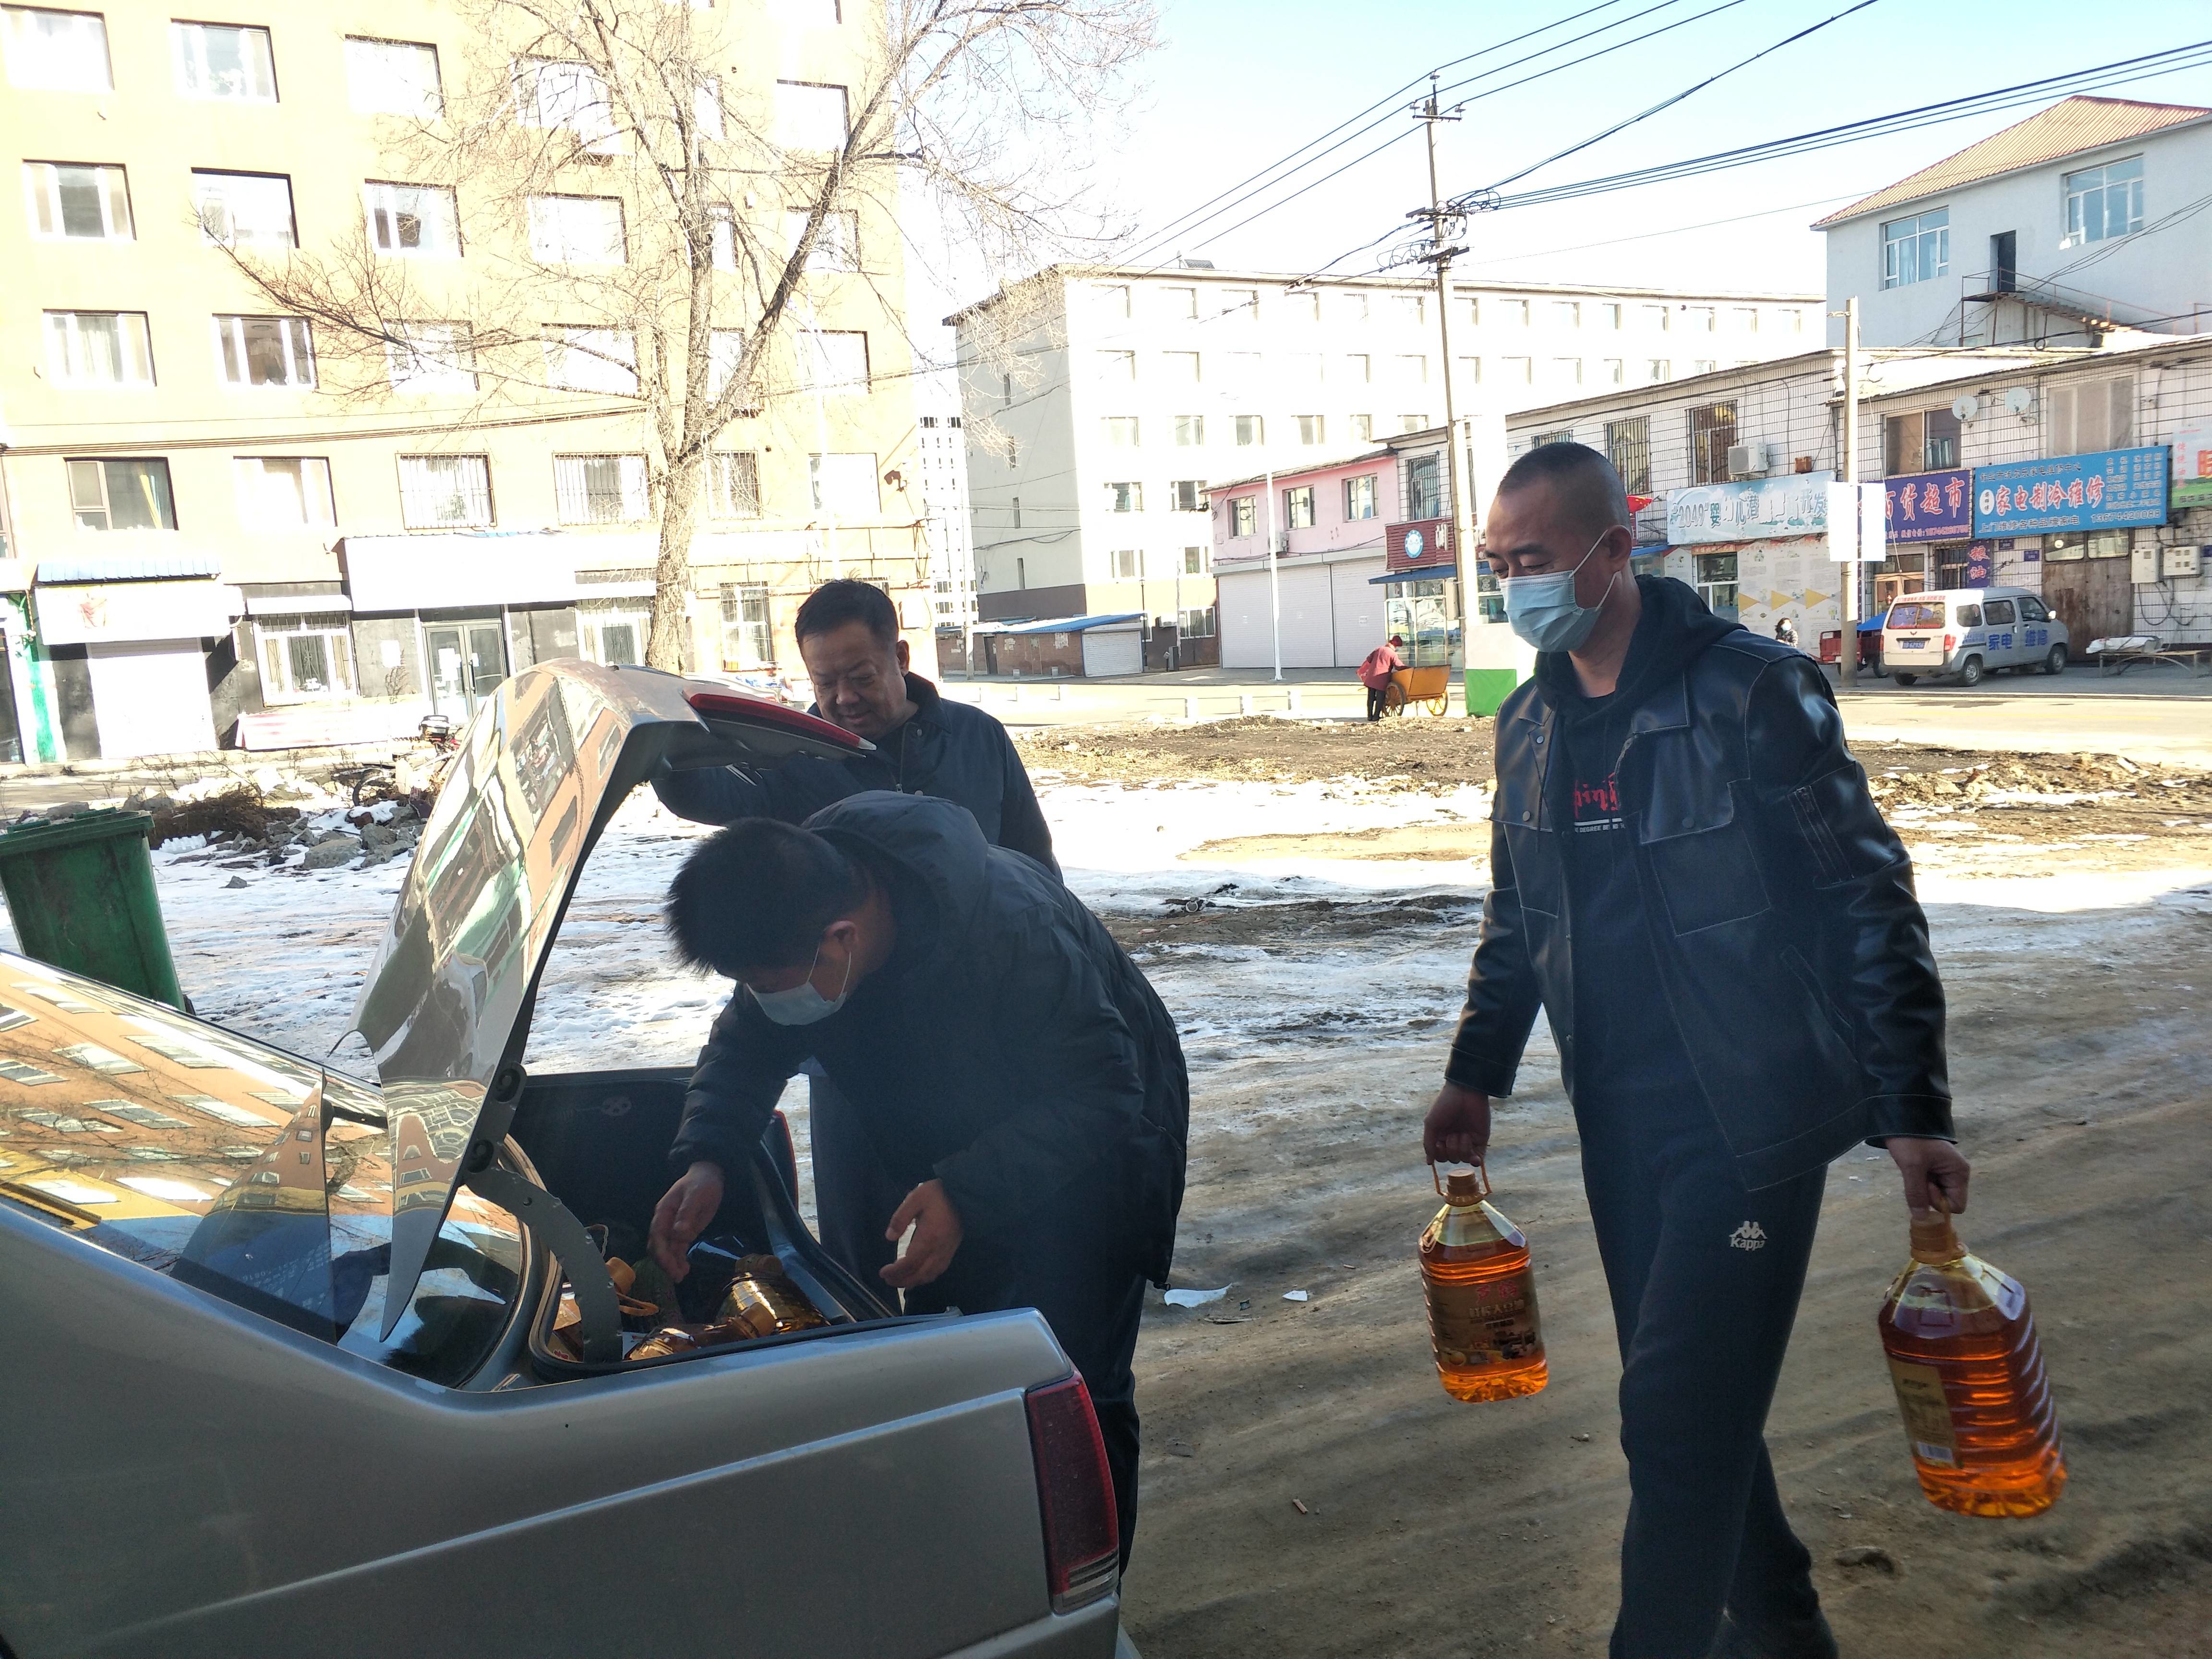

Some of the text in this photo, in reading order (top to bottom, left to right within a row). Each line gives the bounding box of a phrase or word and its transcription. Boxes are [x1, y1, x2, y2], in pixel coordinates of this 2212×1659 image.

[1996, 475, 2104, 516] 家电制冷维修
[1979, 509, 2160, 533] 上门维修各种品牌家电 13674420088
[1969, 545, 1991, 579] 粮油
[1988, 634, 2012, 650] 家电
[2025, 629, 2048, 647] 维修
[1730, 1237, 1766, 1251] Kappa
